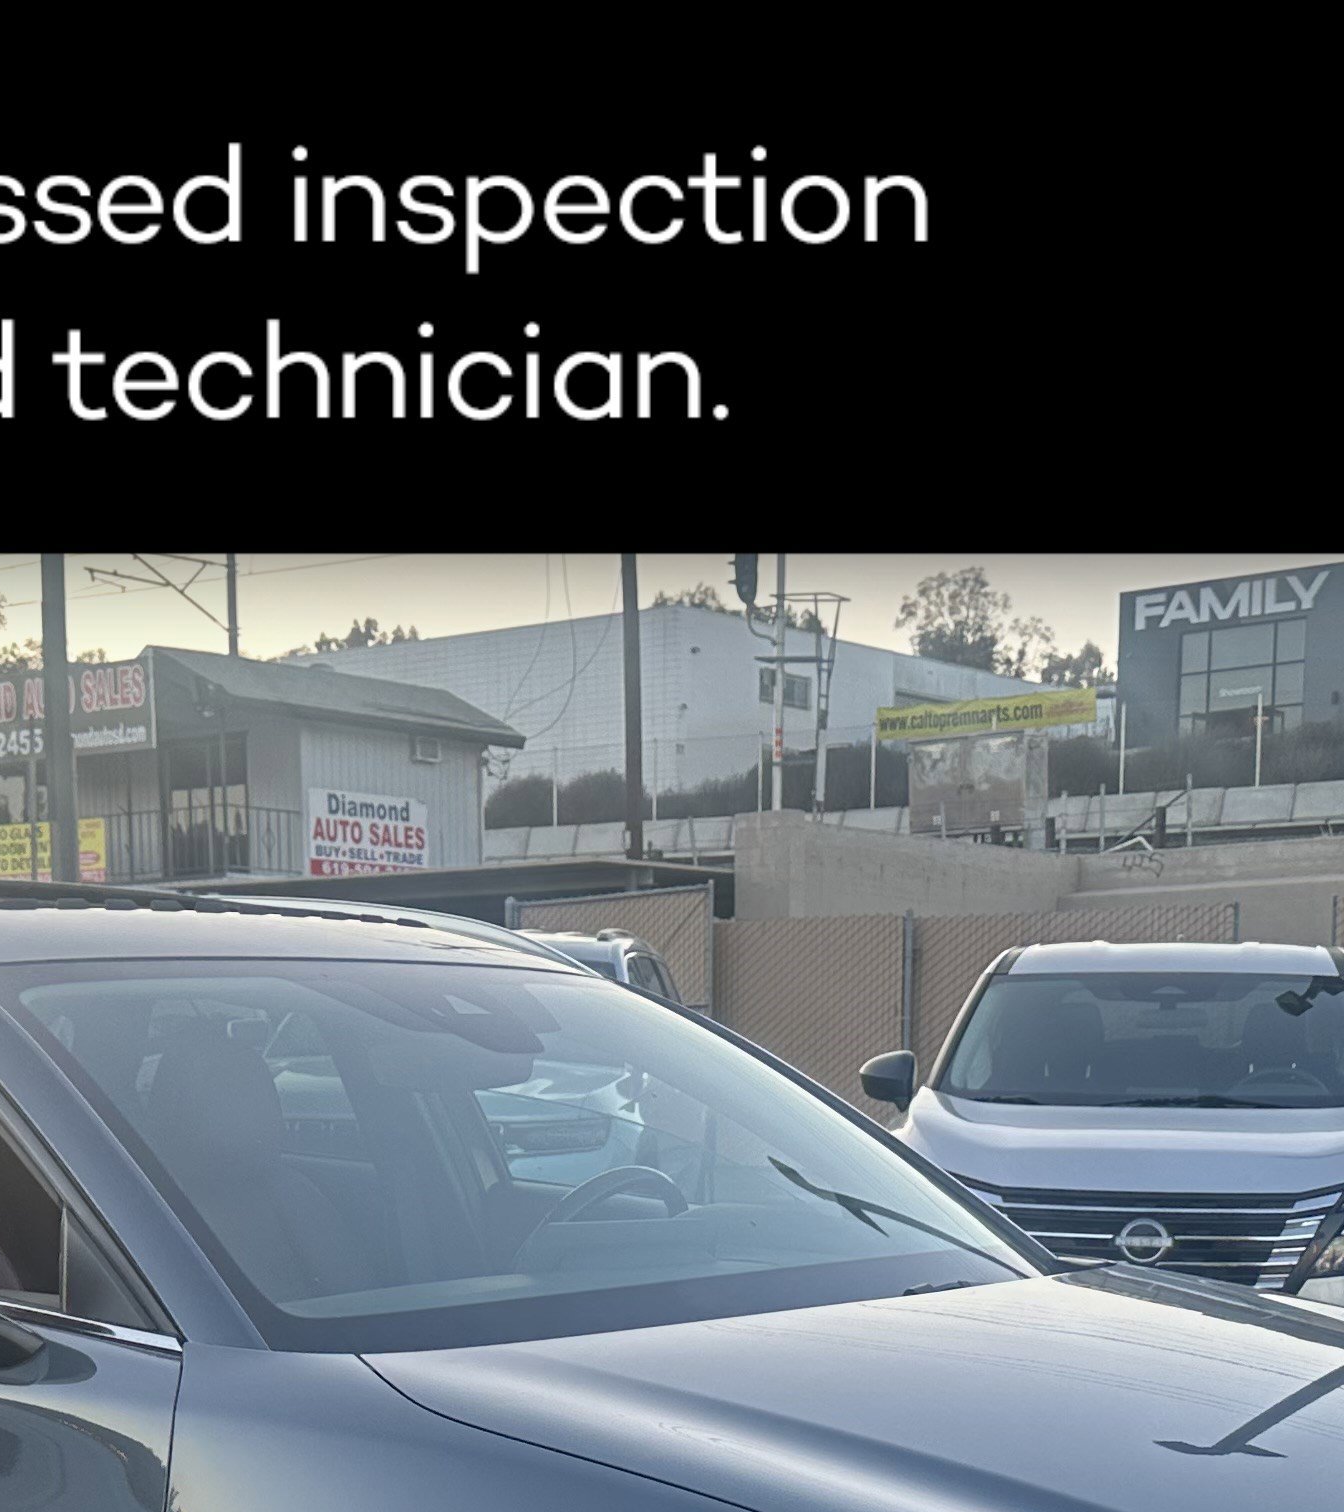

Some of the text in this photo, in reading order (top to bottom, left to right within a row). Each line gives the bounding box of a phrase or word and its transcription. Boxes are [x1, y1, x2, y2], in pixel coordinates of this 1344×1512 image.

[1134, 570, 1332, 632] FAMILY
[81, 664, 146, 713] SALES
[327, 793, 411, 822] Diamond
[313, 817, 425, 850] AUTO SALES
